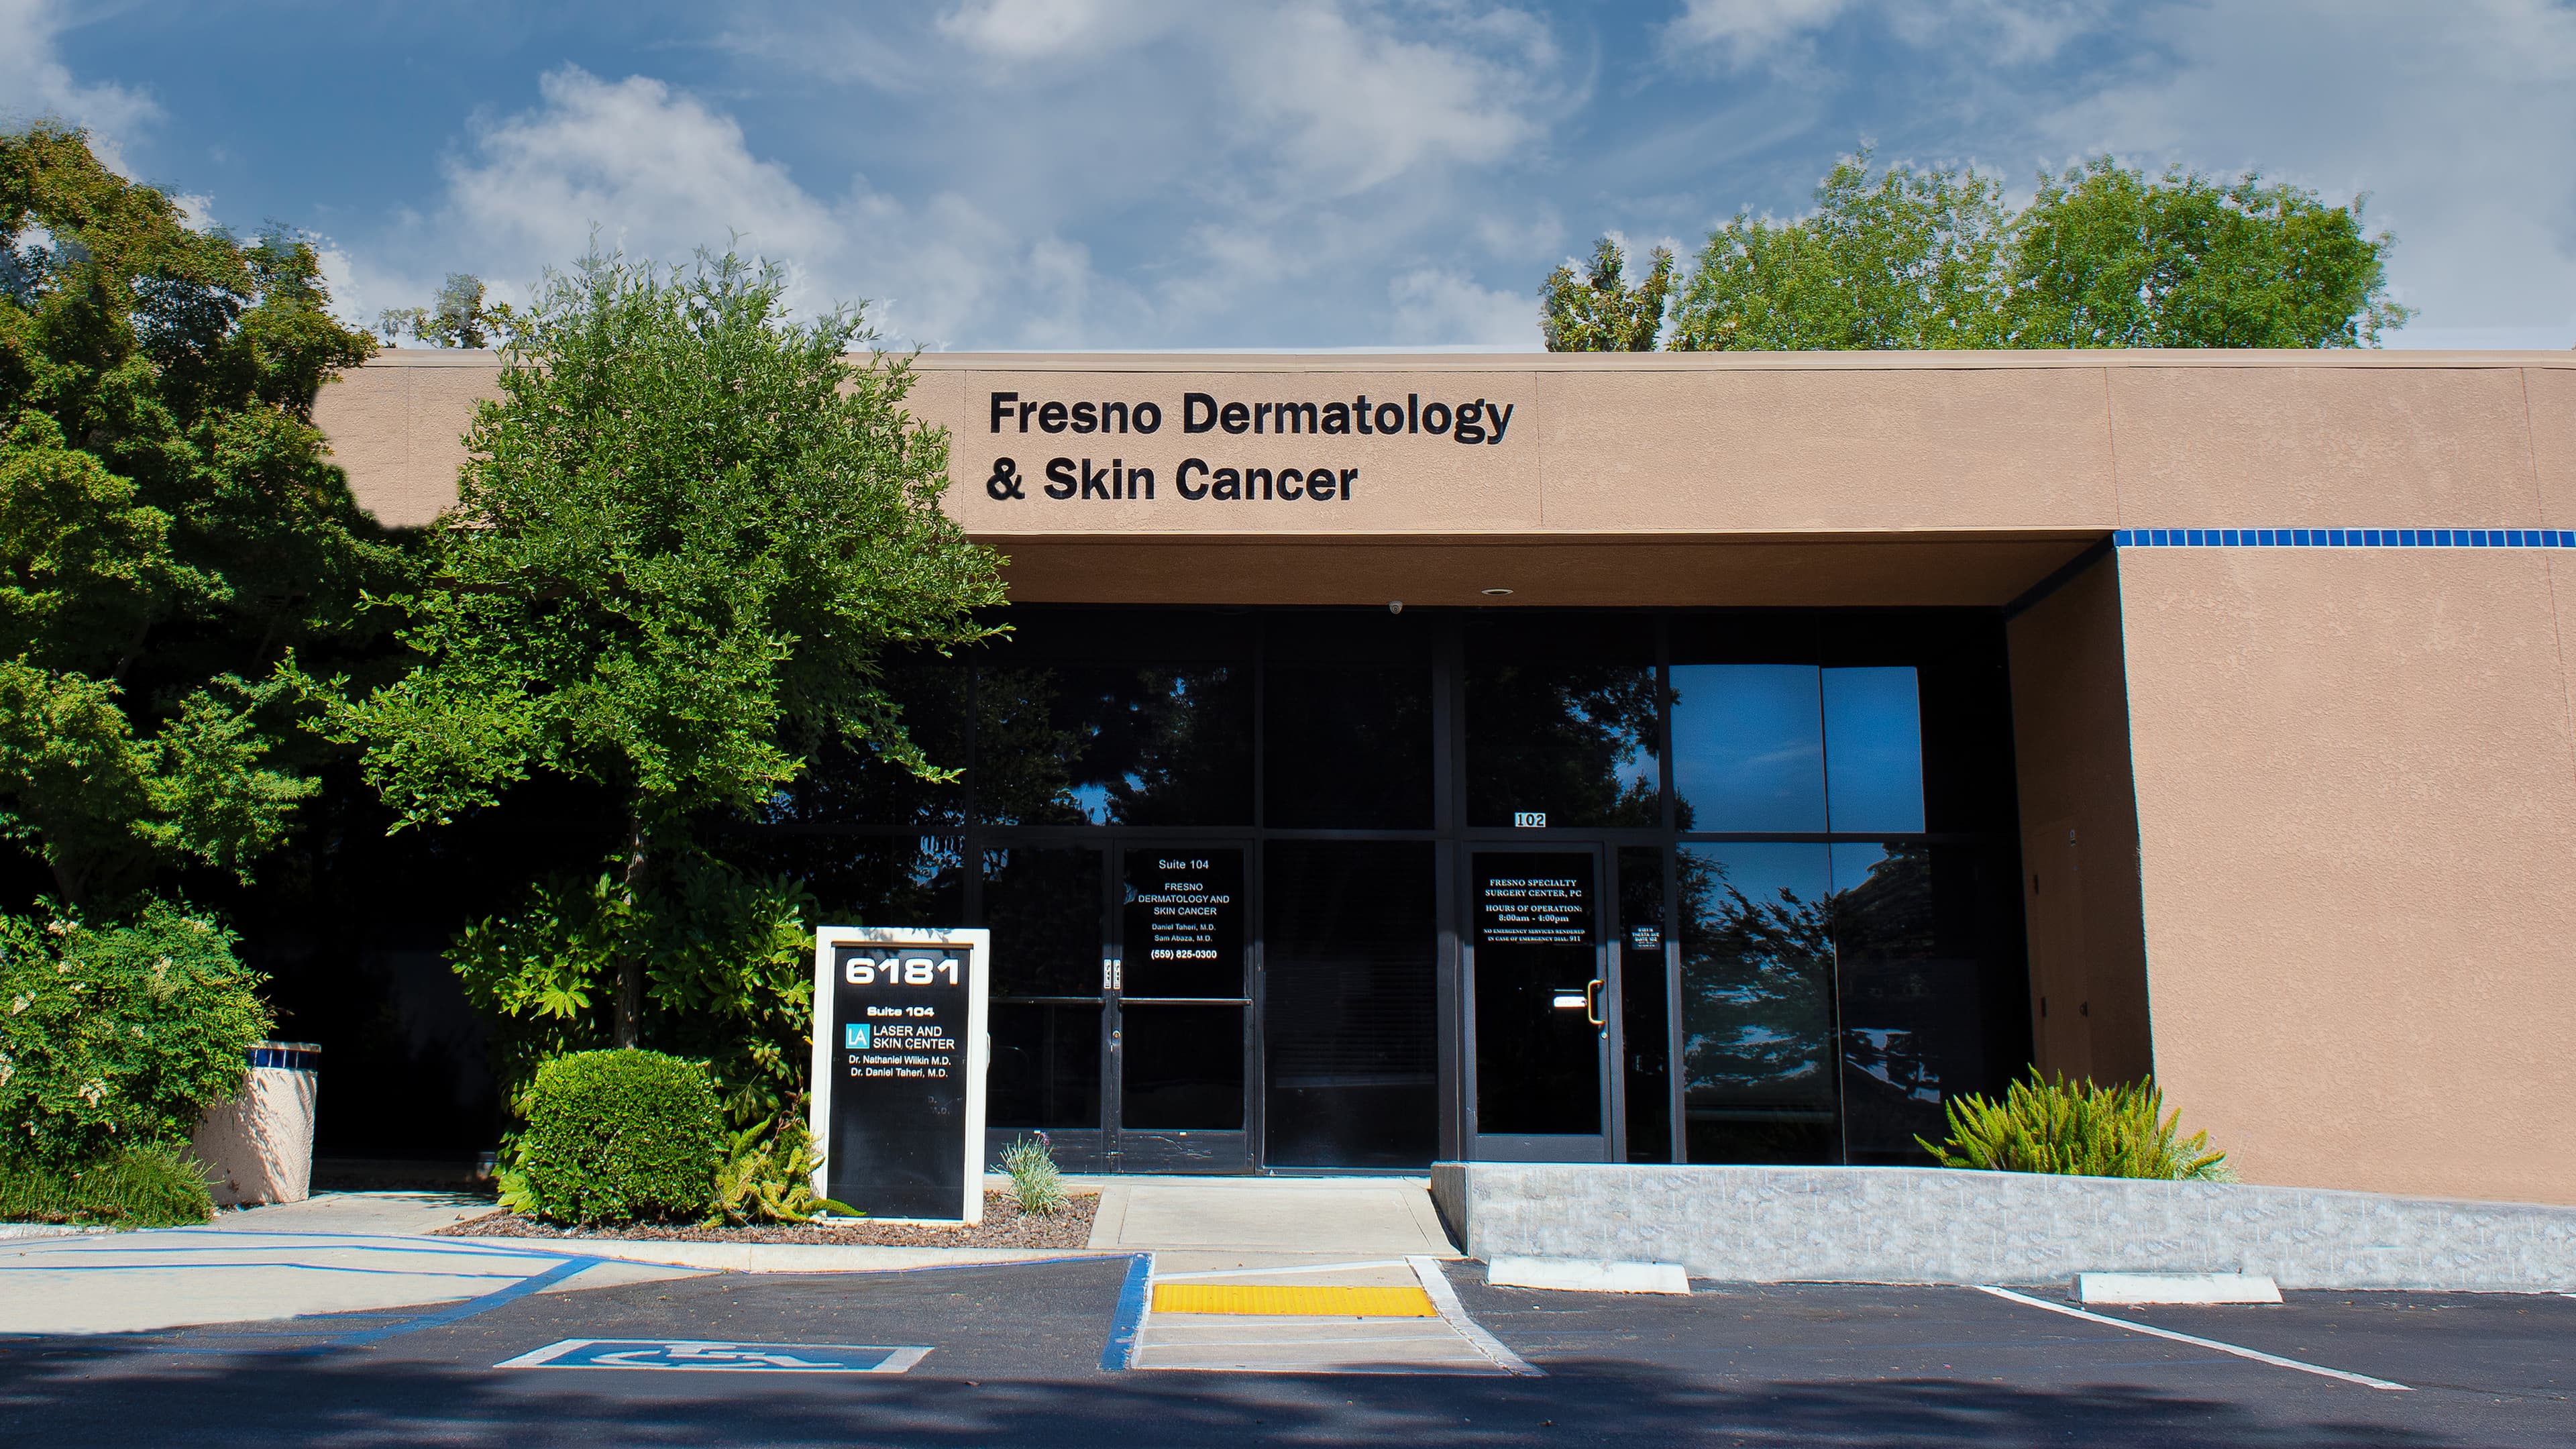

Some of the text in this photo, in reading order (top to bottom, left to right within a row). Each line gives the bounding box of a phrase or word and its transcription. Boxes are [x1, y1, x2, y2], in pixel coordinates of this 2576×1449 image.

[991, 392, 1513, 445] Fresno Dermatology
[986, 458, 1358, 501] & Skin Cancer
[1518, 814, 1544, 826] 102
[1159, 859, 1208, 869] Suite 104
[1165, 882, 1203, 892] FRESNO
[1490, 879, 1577, 887] FRESNO SPECIALTY
[1138, 894, 1230, 904] DERMATOLOGY AND
[1528, 890, 1568, 898] CENTER,
[1153, 907, 1217, 916] SKIN CANCER
[1486, 904, 1515, 912] HOURS
[1499, 914, 1530, 922] 8:00am
[1538, 914, 1569, 924] 4:00pm
[1175, 923, 1198, 931] Taheri,
[1199, 923, 1216, 931] M.D.
[1171, 934, 1195, 943] Abaza,
[1151, 949, 1218, 959] (559) 825-0300
[846, 958, 958, 984] 6181
[867, 1007, 934, 1016] Suite 104
[874, 1026, 942, 1036] LASER AND
[849, 1028, 867, 1045] LA
[873, 1038, 955, 1049] SKIN CENTER
[849, 1055, 951, 1065] Dr. Nathaniel Wilkin M.D.
[851, 1067, 949, 1077] Dr. Daniel Taheri, M.D.
